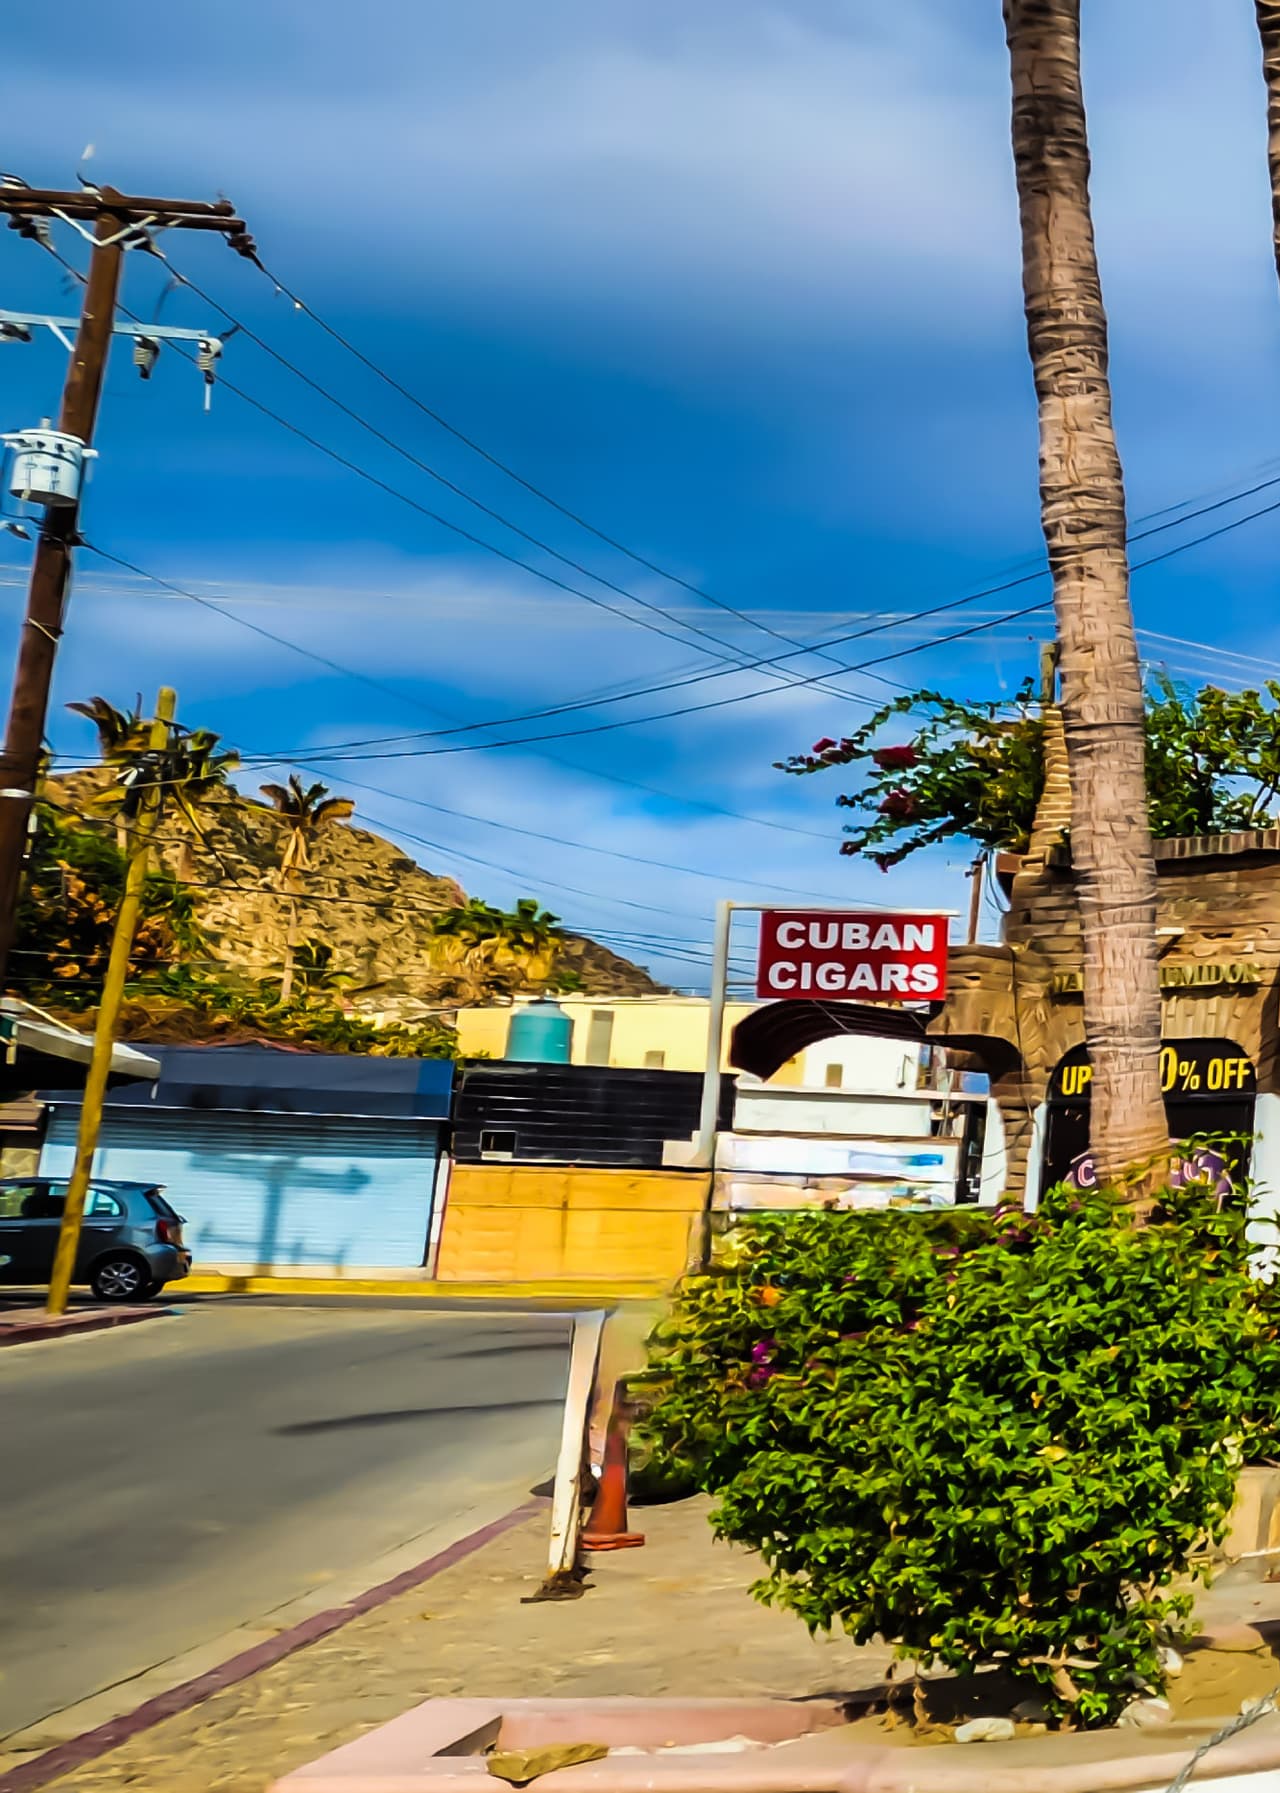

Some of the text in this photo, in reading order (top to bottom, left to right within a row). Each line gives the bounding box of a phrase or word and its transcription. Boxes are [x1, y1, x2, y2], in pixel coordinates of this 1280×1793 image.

[776, 921, 934, 952] CUBAN
[768, 961, 939, 993] CIGARS
[1061, 1065, 1094, 1096] UP
[1207, 1057, 1251, 1091] OFF
